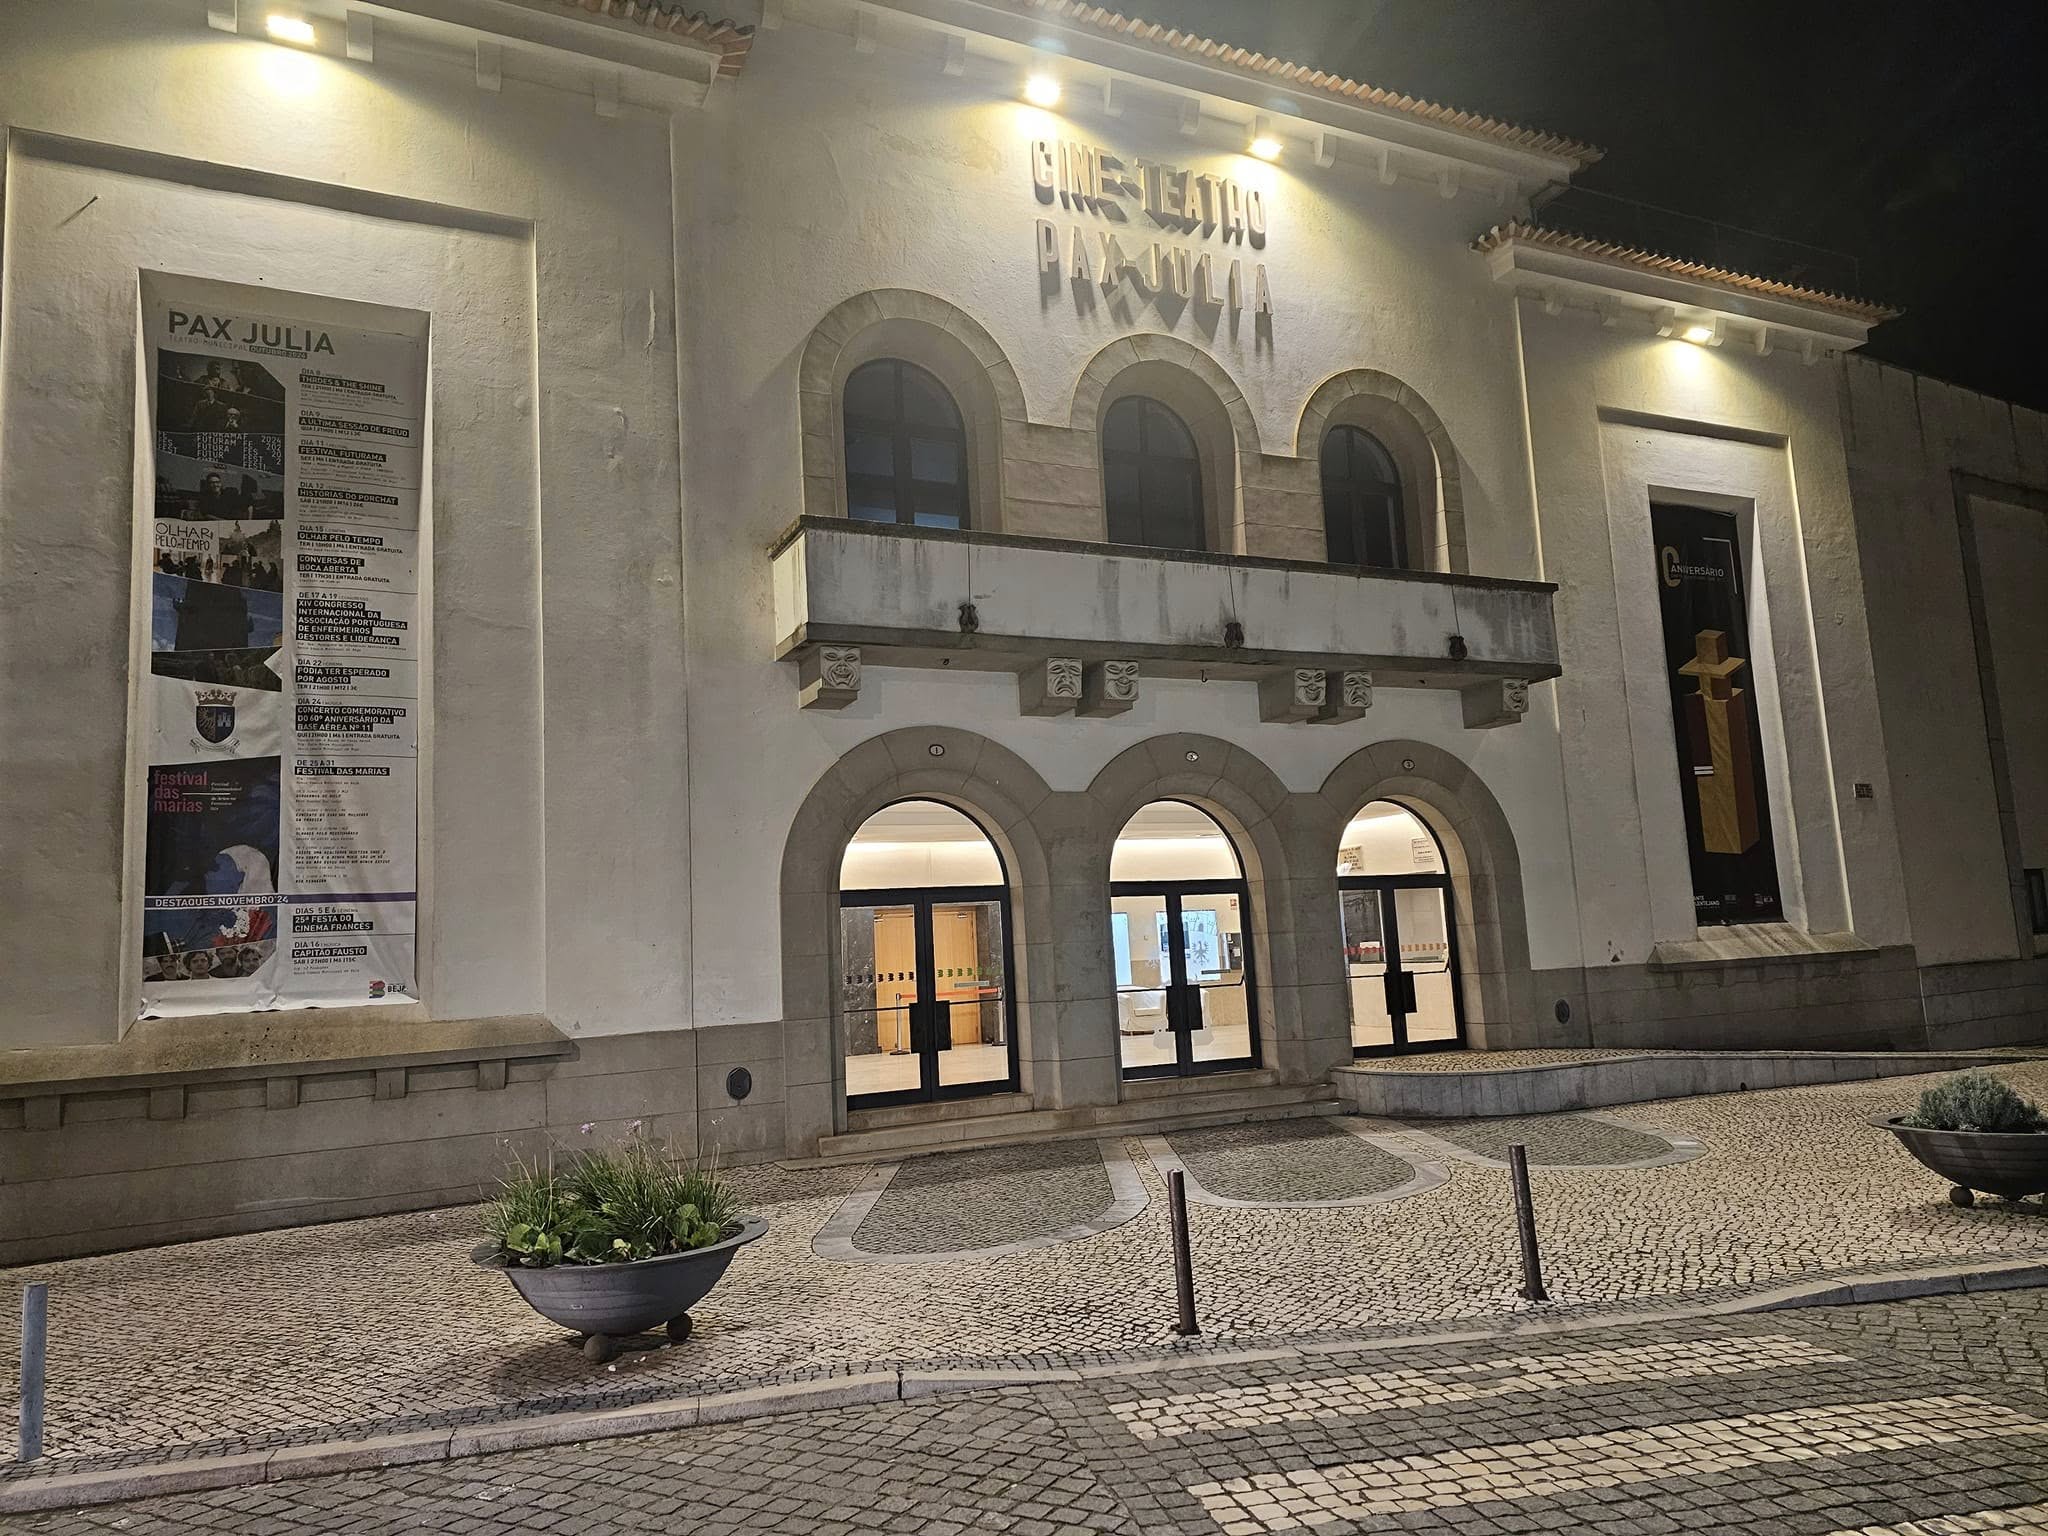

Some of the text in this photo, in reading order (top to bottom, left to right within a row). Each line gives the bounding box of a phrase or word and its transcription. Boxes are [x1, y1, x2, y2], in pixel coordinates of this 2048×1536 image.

[168, 310, 336, 355] PAX JULIA
[371, 425, 380, 433] DE
[382, 427, 408, 438] FREUD
[301, 446, 384, 462] FESTIVAL FUTURAMA
[346, 492, 357, 500] DO
[359, 493, 397, 504] PORCHAT
[155, 522, 211, 540] OLHAR
[155, 533, 210, 551] PELO TEMPO
[299, 532, 382, 545] OLHAR PELO TEMPO
[299, 555, 361, 566] CONVERSAS DE
[299, 563, 356, 573] BOCA ABERTA
[299, 591, 310, 599] DE
[313, 601, 364, 609] CONGRESSO
[298, 608, 379, 619] INTERNACIONAL DA
[351, 619, 406, 629] PORTUGUESA
[311, 626, 371, 635] ENFERMEIROS
[297, 634, 341, 642] GESTORES
[297, 666, 387, 677] PODIA TER ESPERADO
[297, 675, 349, 684] POR AGOSTO
[297, 706, 405, 716] CONCERTO COMEMORATIVO
[297, 714, 309, 722] DO
[380, 716, 392, 724] DA
[297, 723, 318, 731] BASE
[297, 767, 388, 776] FESTIVAL DAS MARIAS
[153, 769, 208, 786] festival
[154, 785, 180, 800] das
[154, 799, 203, 812] marias
[155, 897, 216, 907] DESTAQUES
[311, 914, 338, 923] FESTA
[340, 914, 351, 922] DO
[294, 923, 329, 932] CINEMA
[332, 947, 365, 956] FAUSTO
